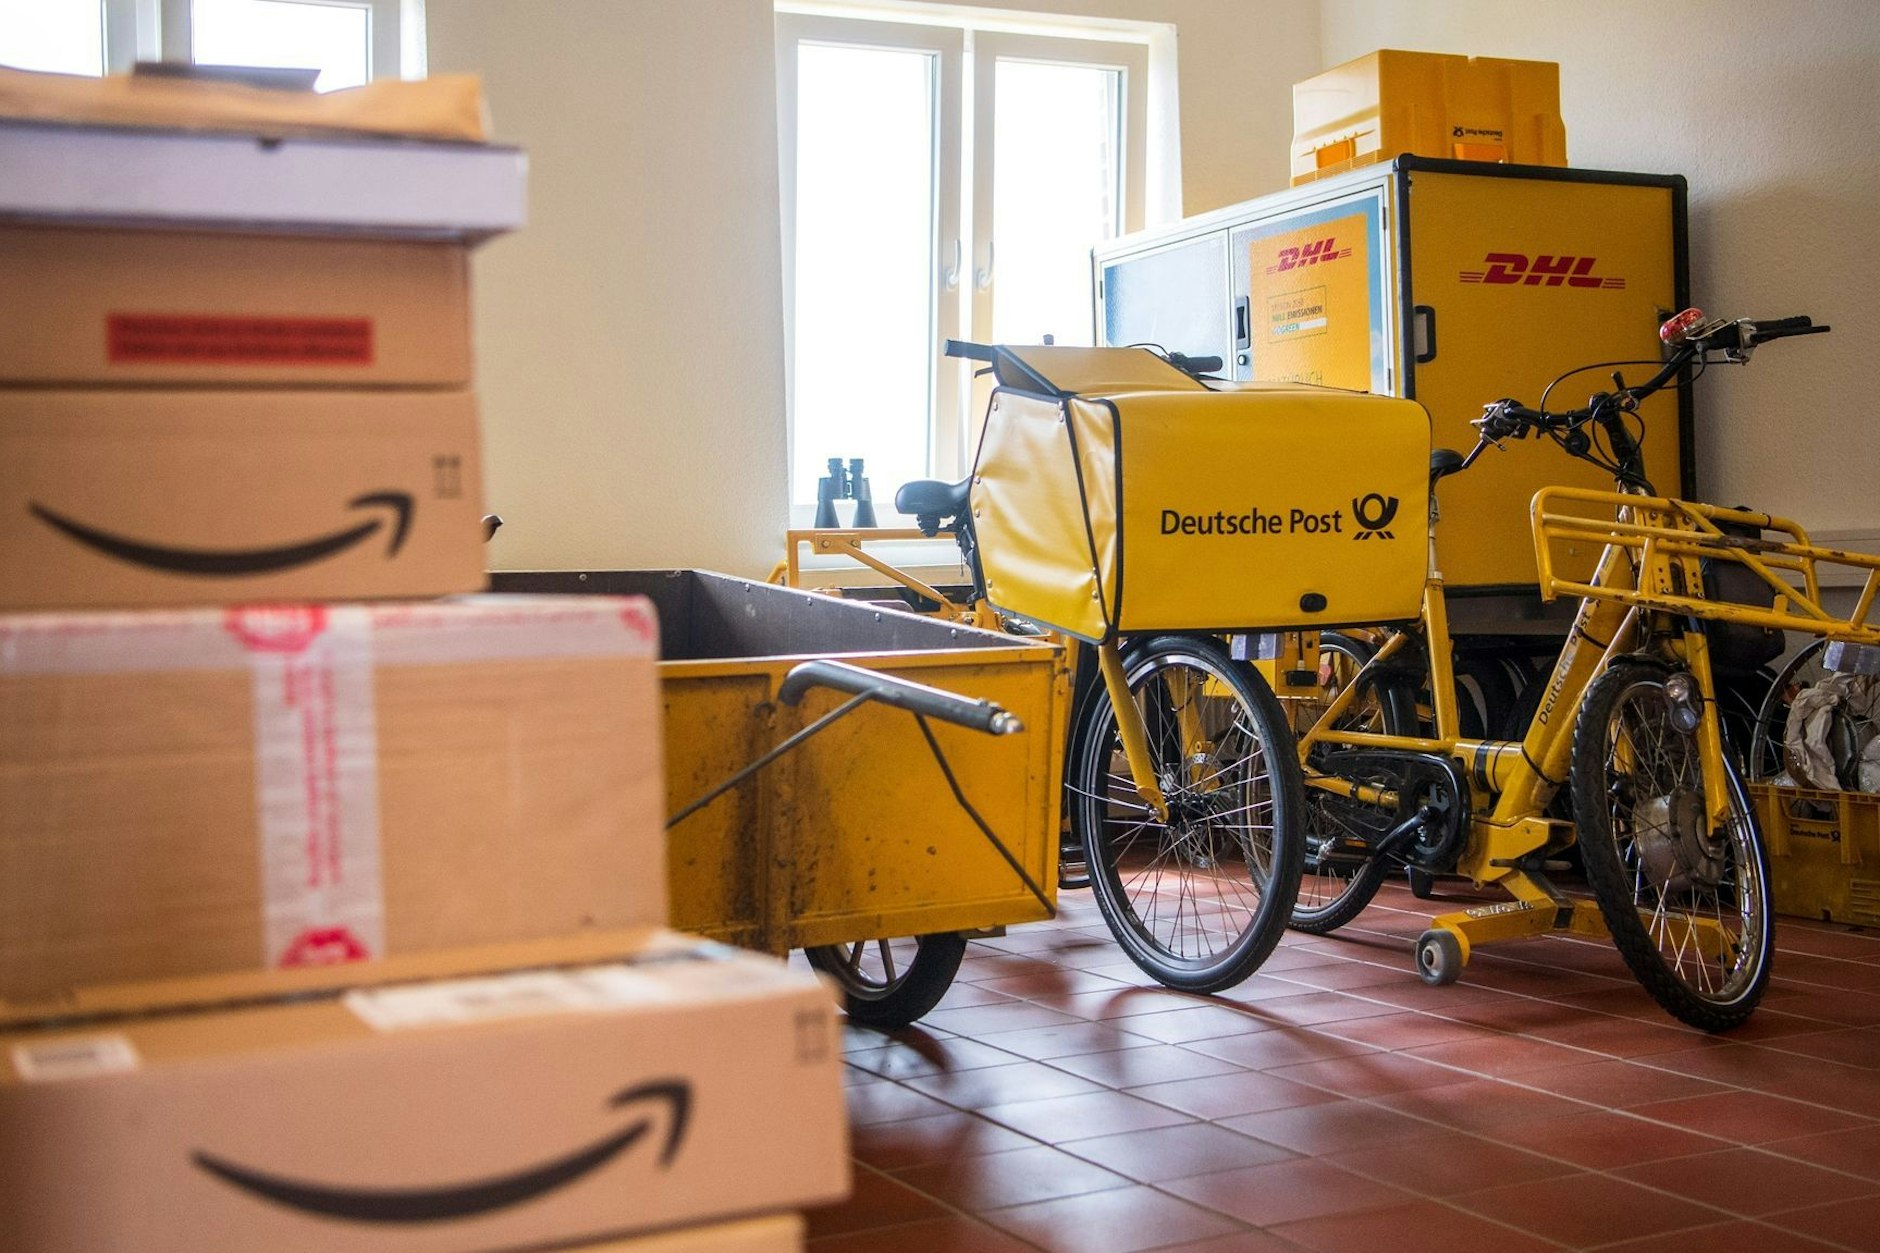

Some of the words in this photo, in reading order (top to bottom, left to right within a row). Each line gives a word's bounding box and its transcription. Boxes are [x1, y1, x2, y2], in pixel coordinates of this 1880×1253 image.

[1278, 238, 1339, 272] DHL
[1482, 252, 1605, 288] DHL
[1287, 305, 1323, 320] EMISSIONEN
[1161, 508, 1282, 535] Deutsche
[1289, 508, 1342, 534] Post
[1538, 652, 1574, 725] Deutsche
